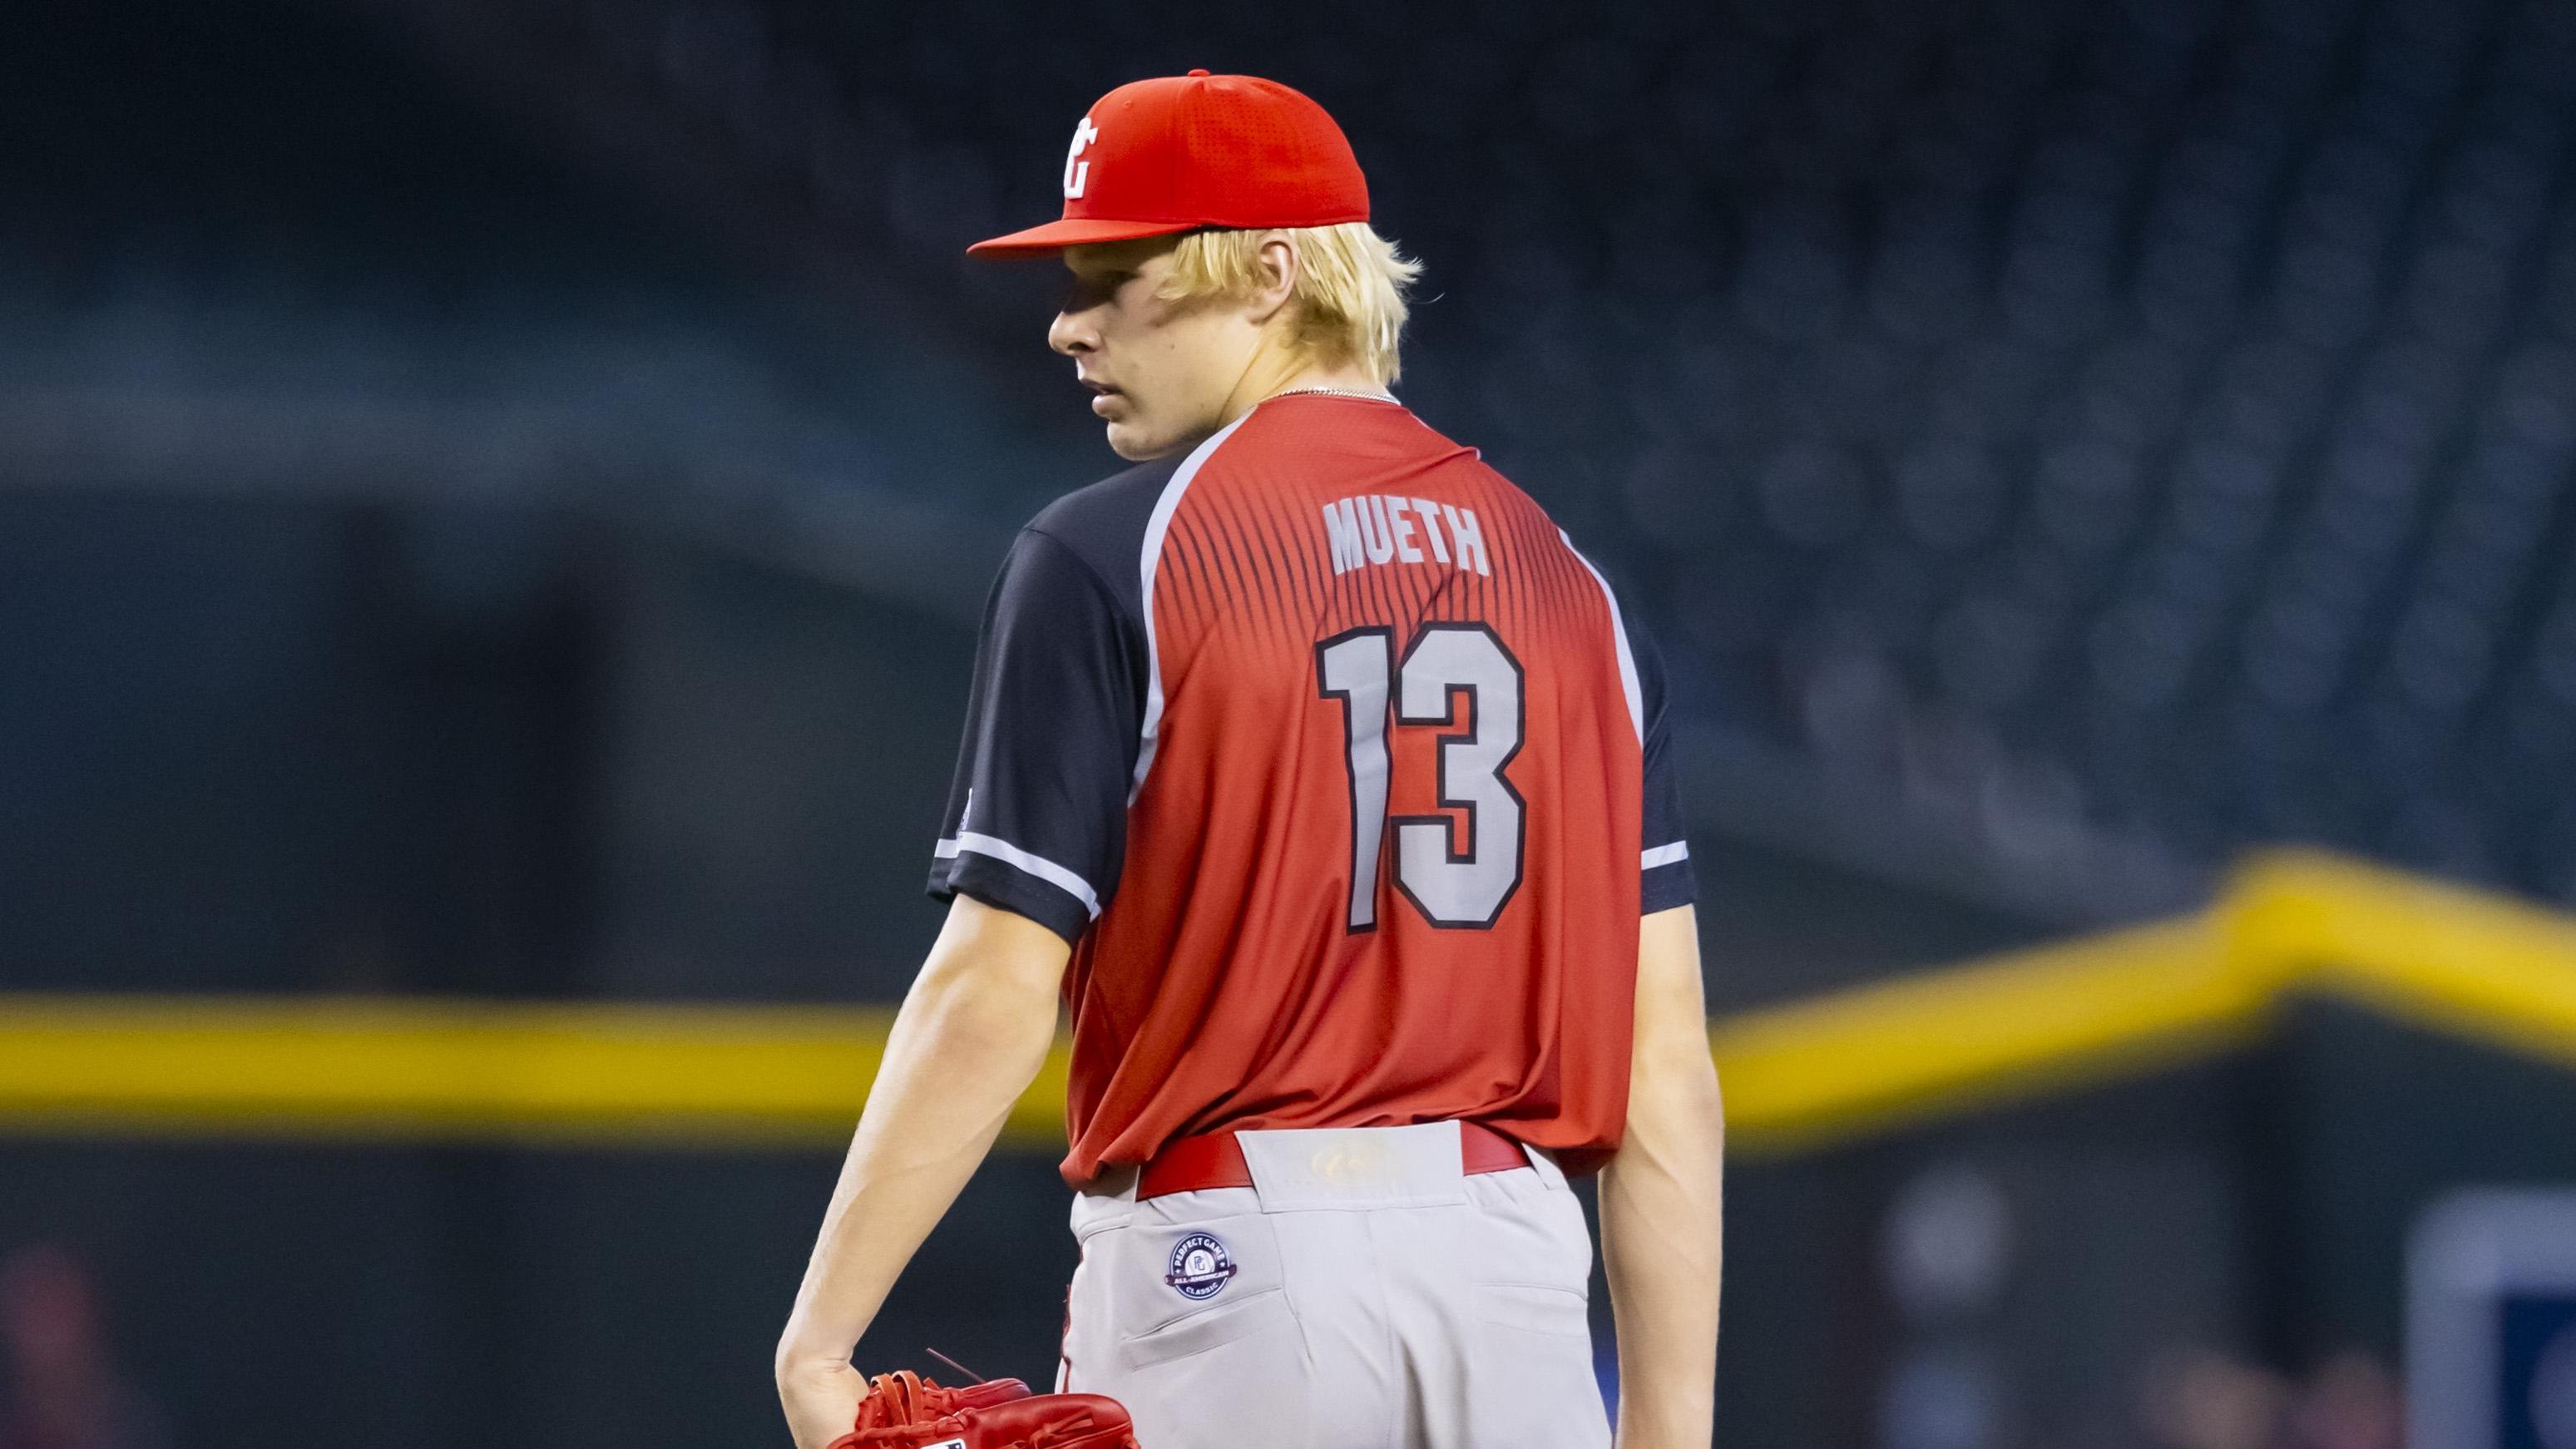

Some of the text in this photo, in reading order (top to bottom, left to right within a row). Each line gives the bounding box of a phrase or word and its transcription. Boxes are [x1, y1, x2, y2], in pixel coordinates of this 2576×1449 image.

[1323, 495, 1490, 576] MUETH
[1314, 621, 1527, 936] 13
[1174, 1237, 1225, 1267] PERFECT GAME
[1185, 1282, 1219, 1295] CLASSIC
